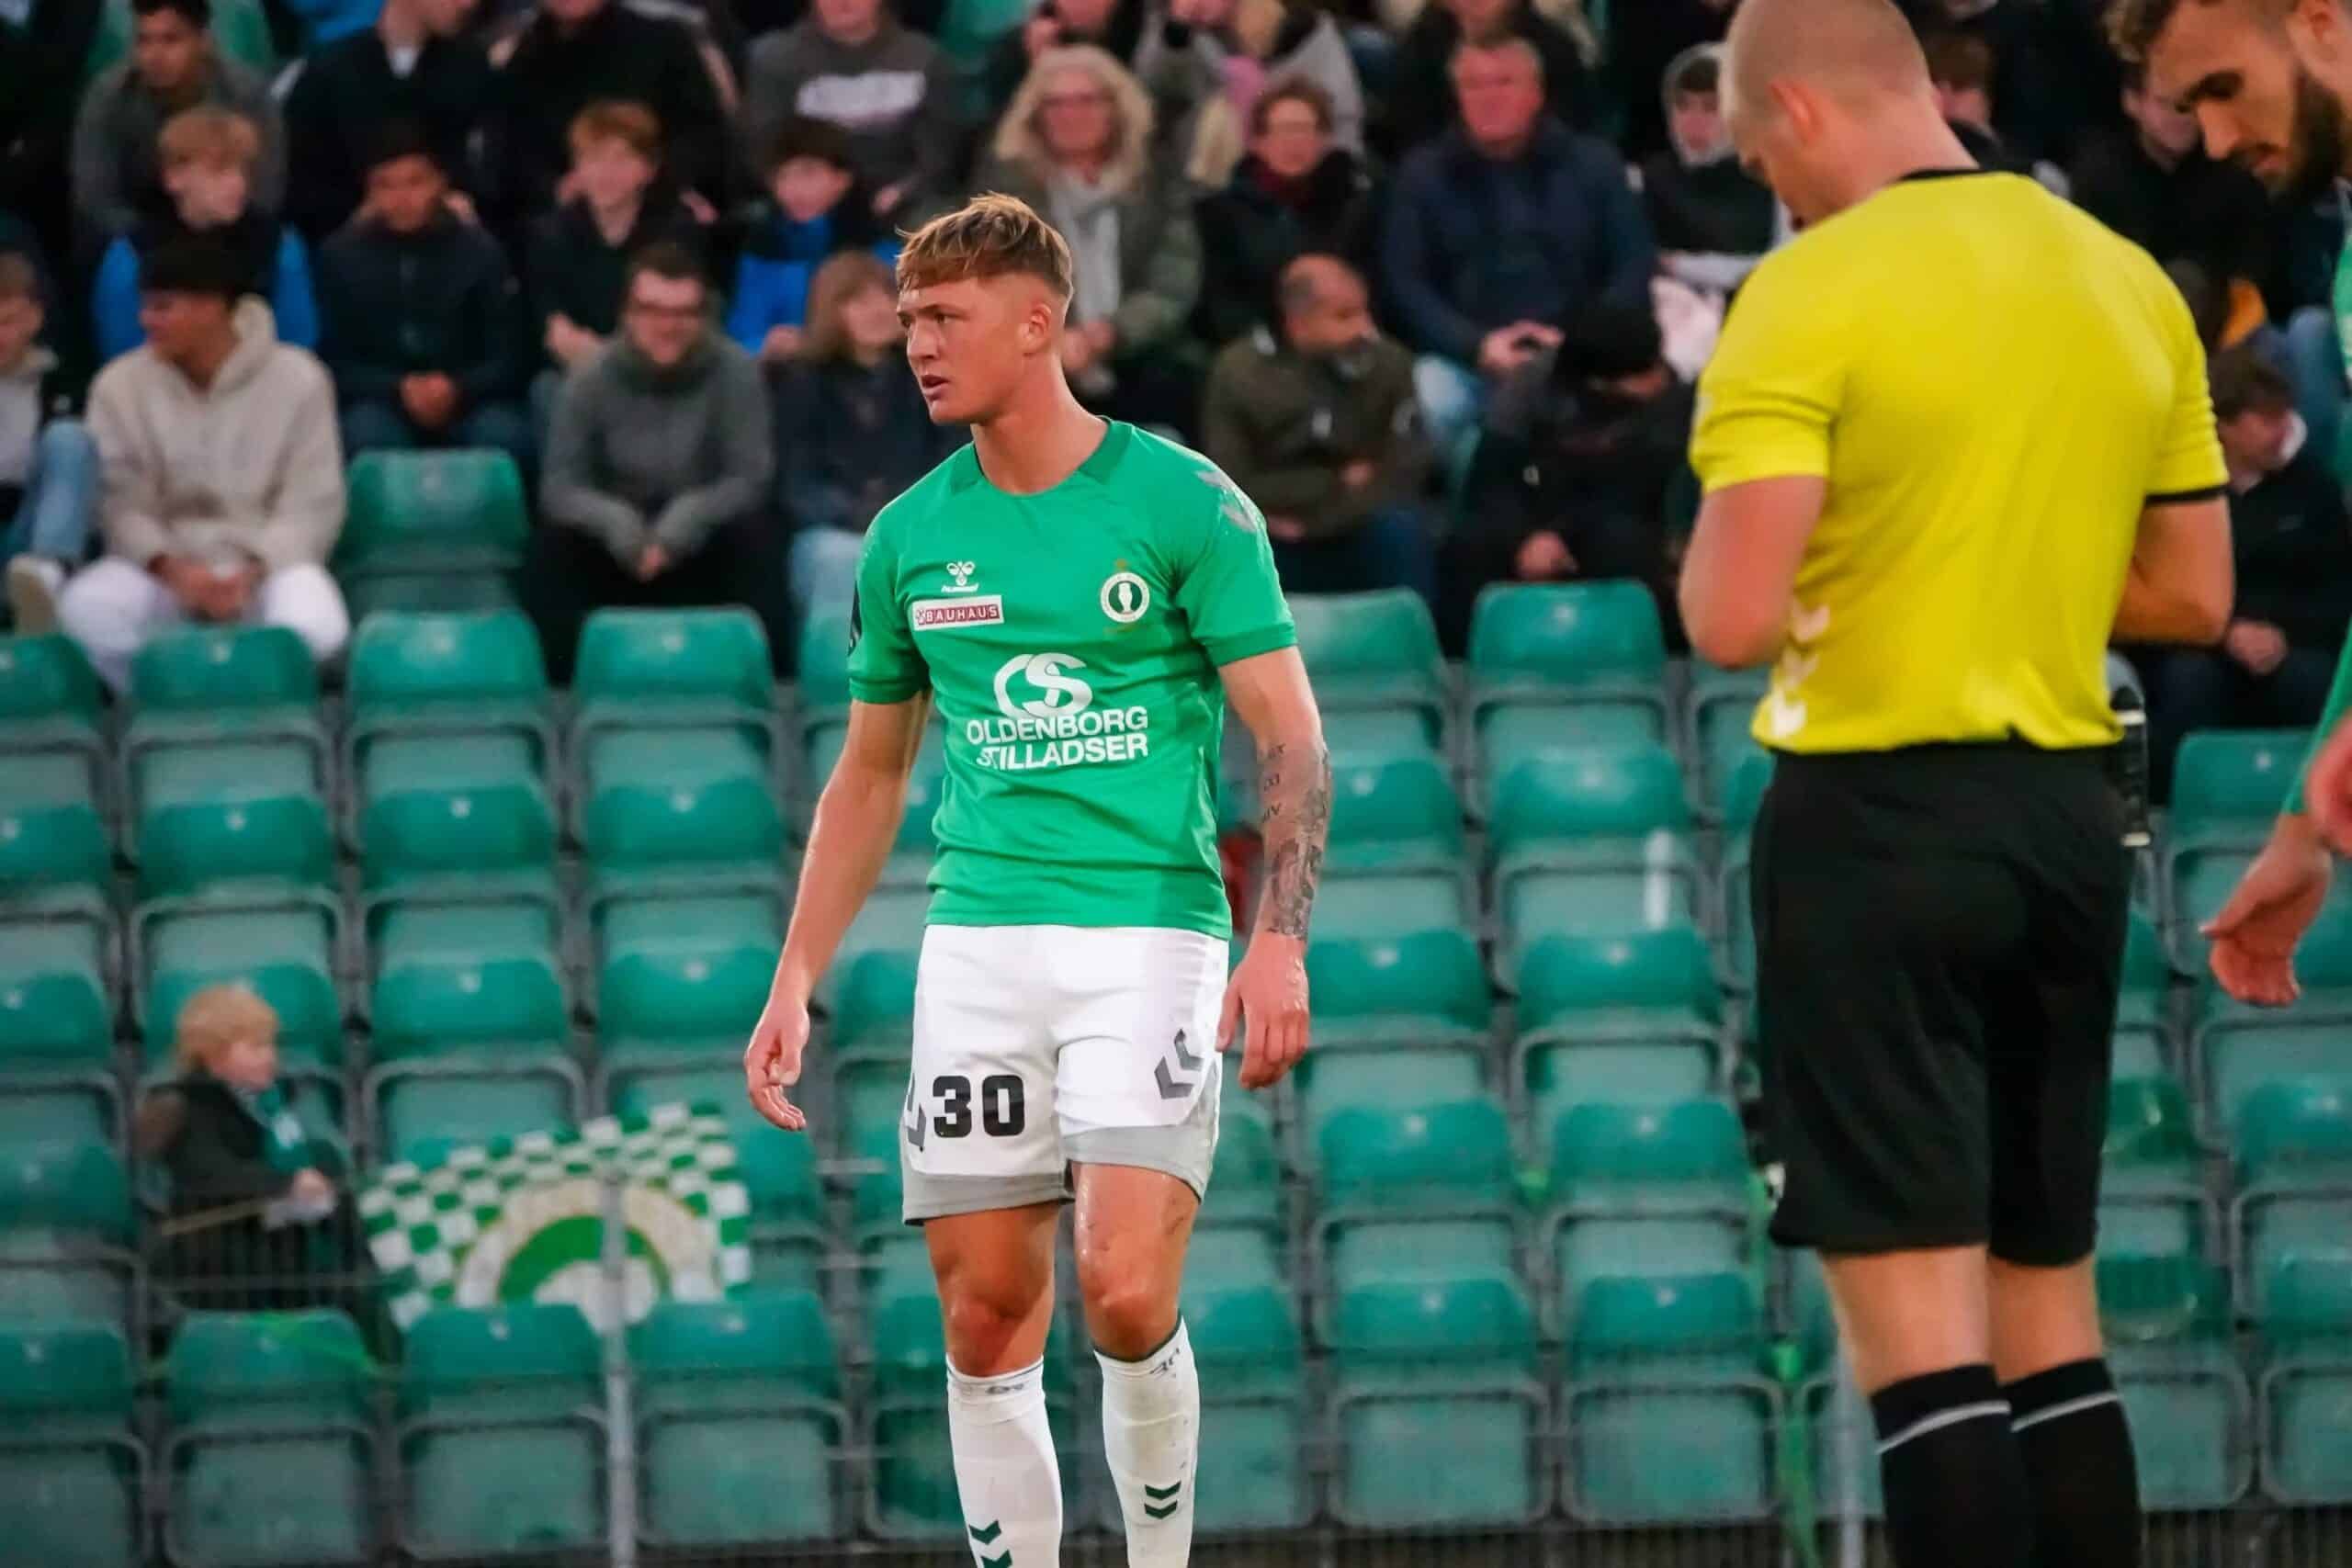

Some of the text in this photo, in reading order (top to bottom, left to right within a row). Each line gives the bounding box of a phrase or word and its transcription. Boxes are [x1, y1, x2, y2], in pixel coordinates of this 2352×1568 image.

[926, 606, 998, 623] BAUHAUS
[967, 706, 1148, 745] OLDENBORG
[976, 734, 1148, 771] STILLADSER
[933, 1075, 1024, 1138] 30
